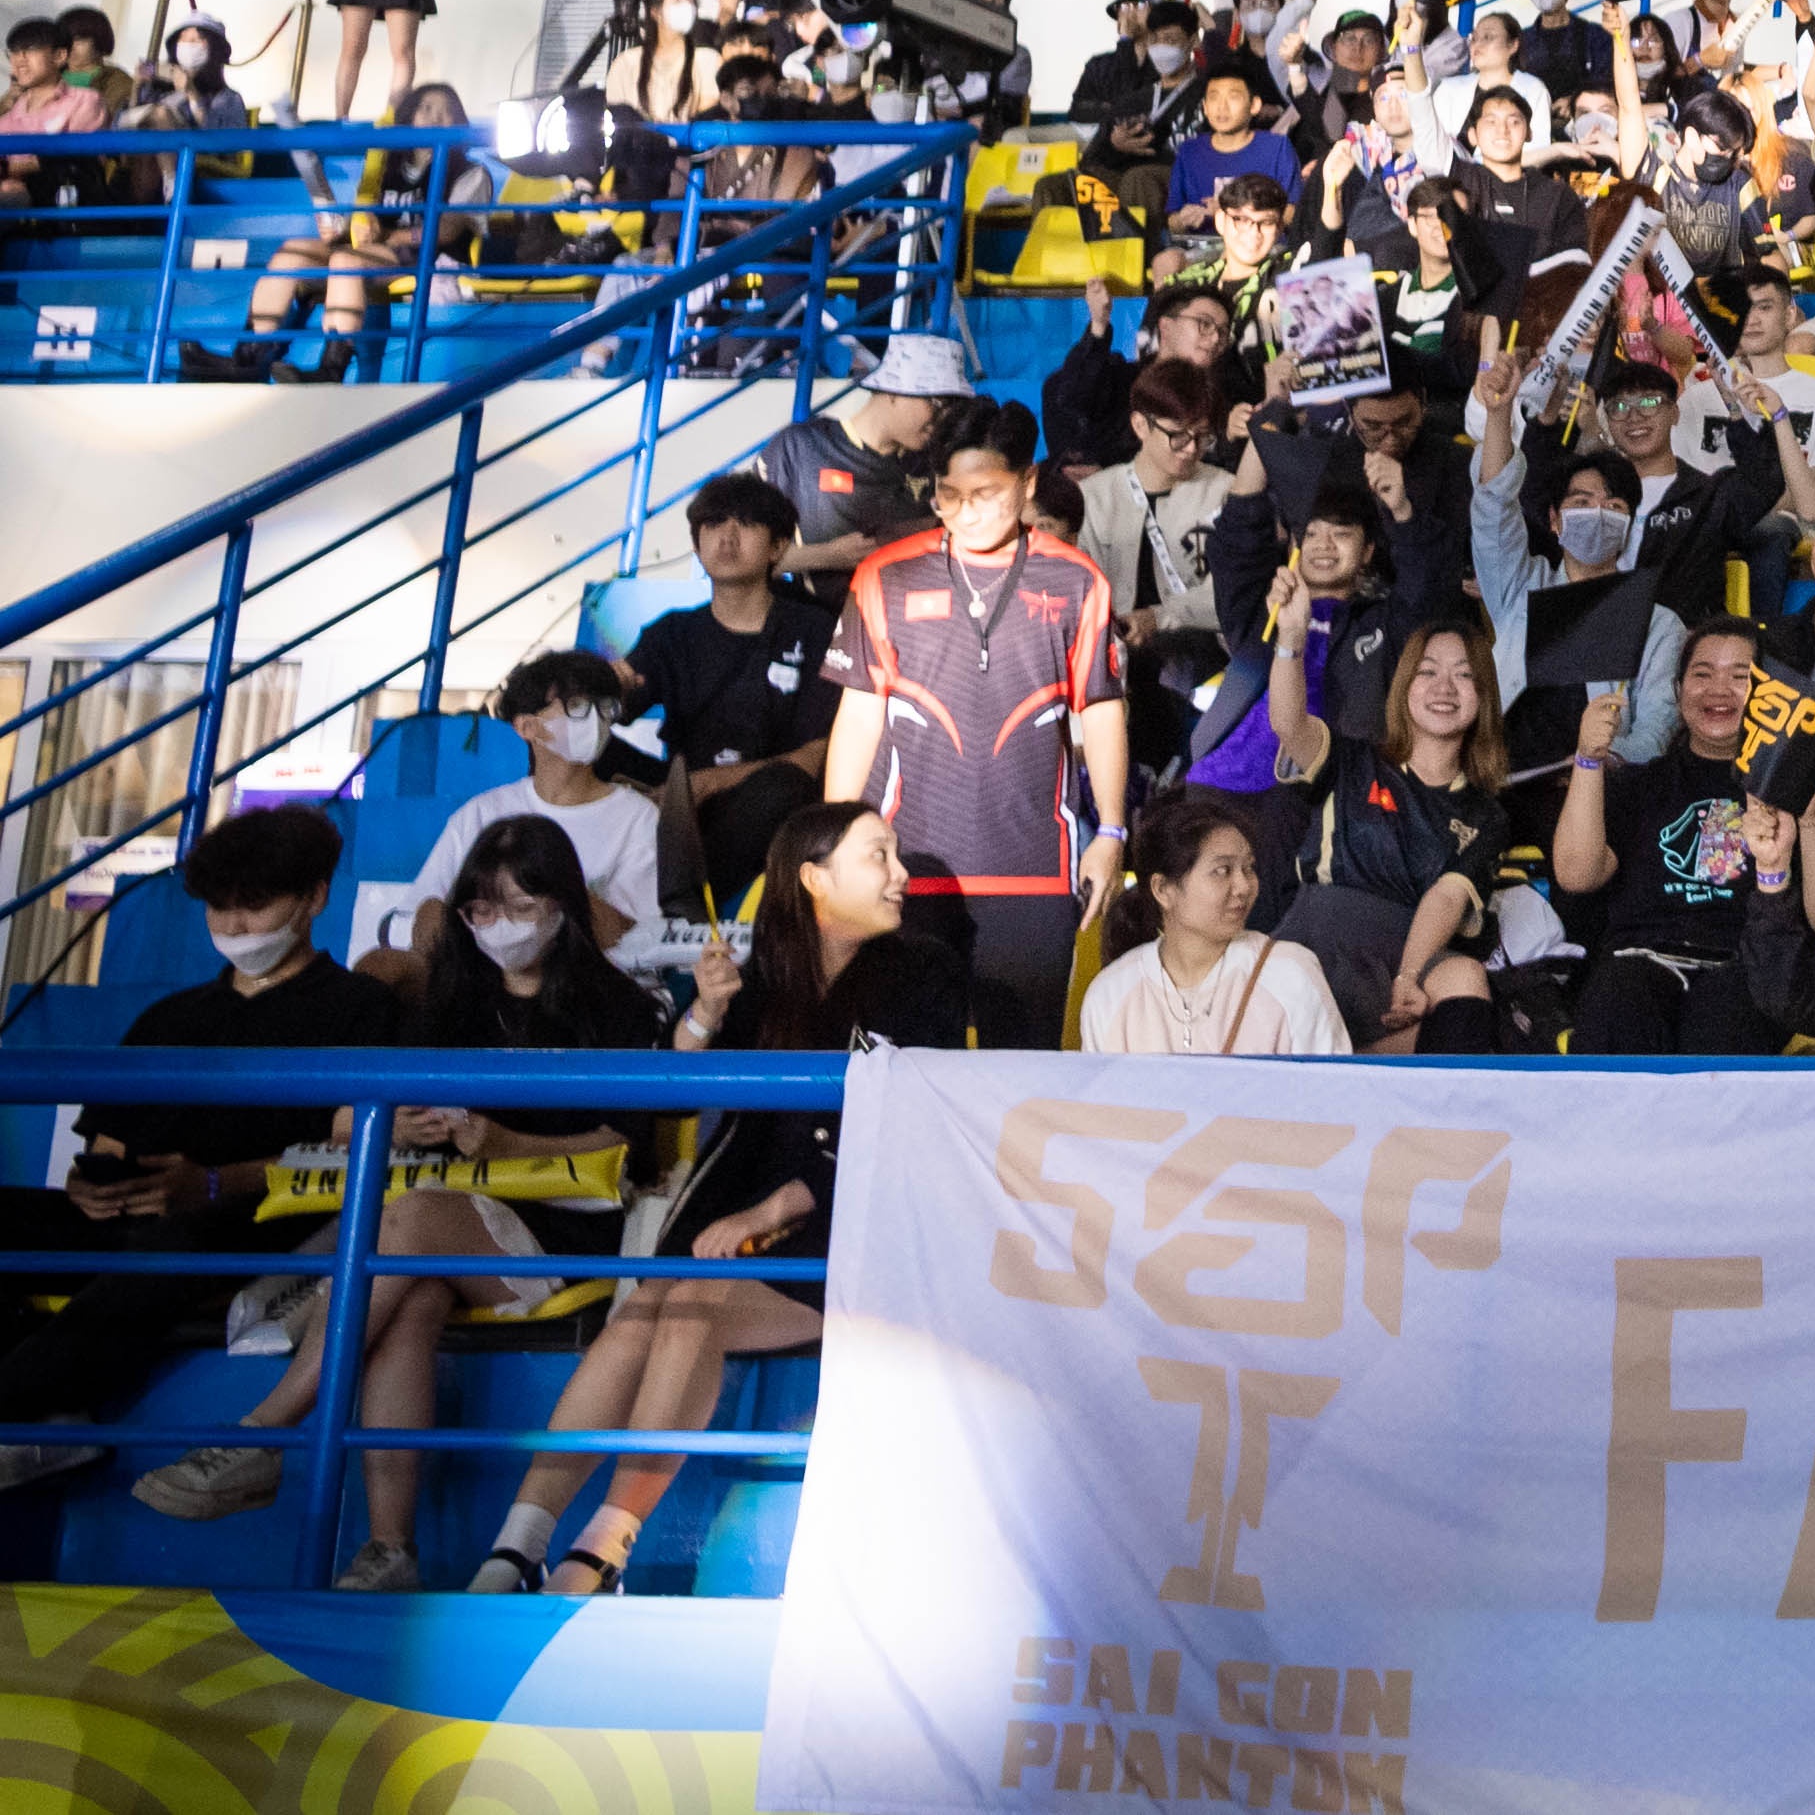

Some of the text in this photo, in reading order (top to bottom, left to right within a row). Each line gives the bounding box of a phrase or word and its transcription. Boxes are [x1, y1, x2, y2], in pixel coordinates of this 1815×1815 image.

[1560, 298, 1603, 356] SAIGON
[1601, 221, 1650, 296] PHANTOM
[989, 1097, 1513, 1339] SGP
[1011, 1637, 1413, 1740] SAI GON
[1001, 1720, 1408, 1815] PHANTOM
